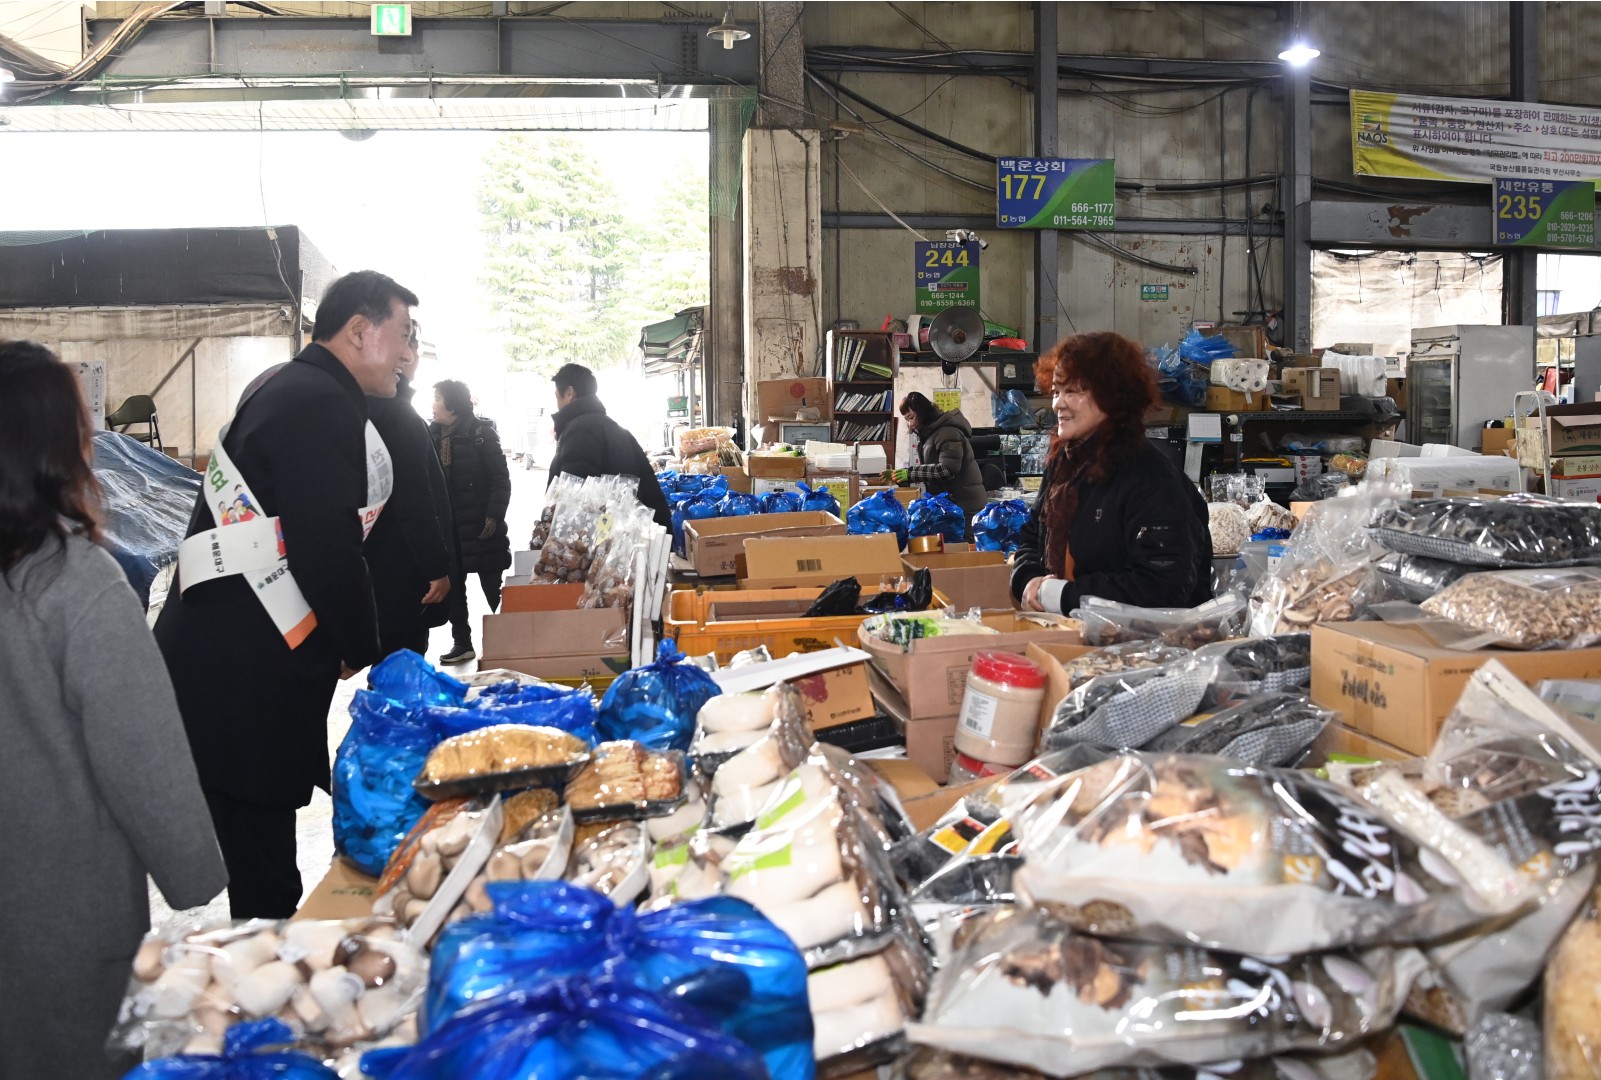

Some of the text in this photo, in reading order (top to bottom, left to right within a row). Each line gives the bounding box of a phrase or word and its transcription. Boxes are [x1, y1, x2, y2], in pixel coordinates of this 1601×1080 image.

[1504, 108, 1540, 121] 포장하여
[1543, 111, 1577, 124] 판매하는
[1579, 114, 1601, 127] 자(생
[1476, 120, 1504, 132] 원산지
[1513, 122, 1532, 133] 주소
[1541, 124, 1579, 137] 상호(또는
[1412, 129, 1496, 145] 표시하여야 합니다.
[1543, 151, 1557, 162] 최고
[1001, 160, 1065, 172] 백운상회
[1553, 168, 1581, 177] 부산사무소
[1001, 174, 1046, 200] 177
[1499, 181, 1553, 193] 새한유통
[1071, 202, 1113, 213] 666-1177
[1499, 195, 1541, 219] 235
[1053, 215, 1113, 226] 011-564-7965
[1560, 211, 1593, 220] 666-1206
[925, 249, 969, 267] 244
[211, 542, 224, 574] 해운대구
